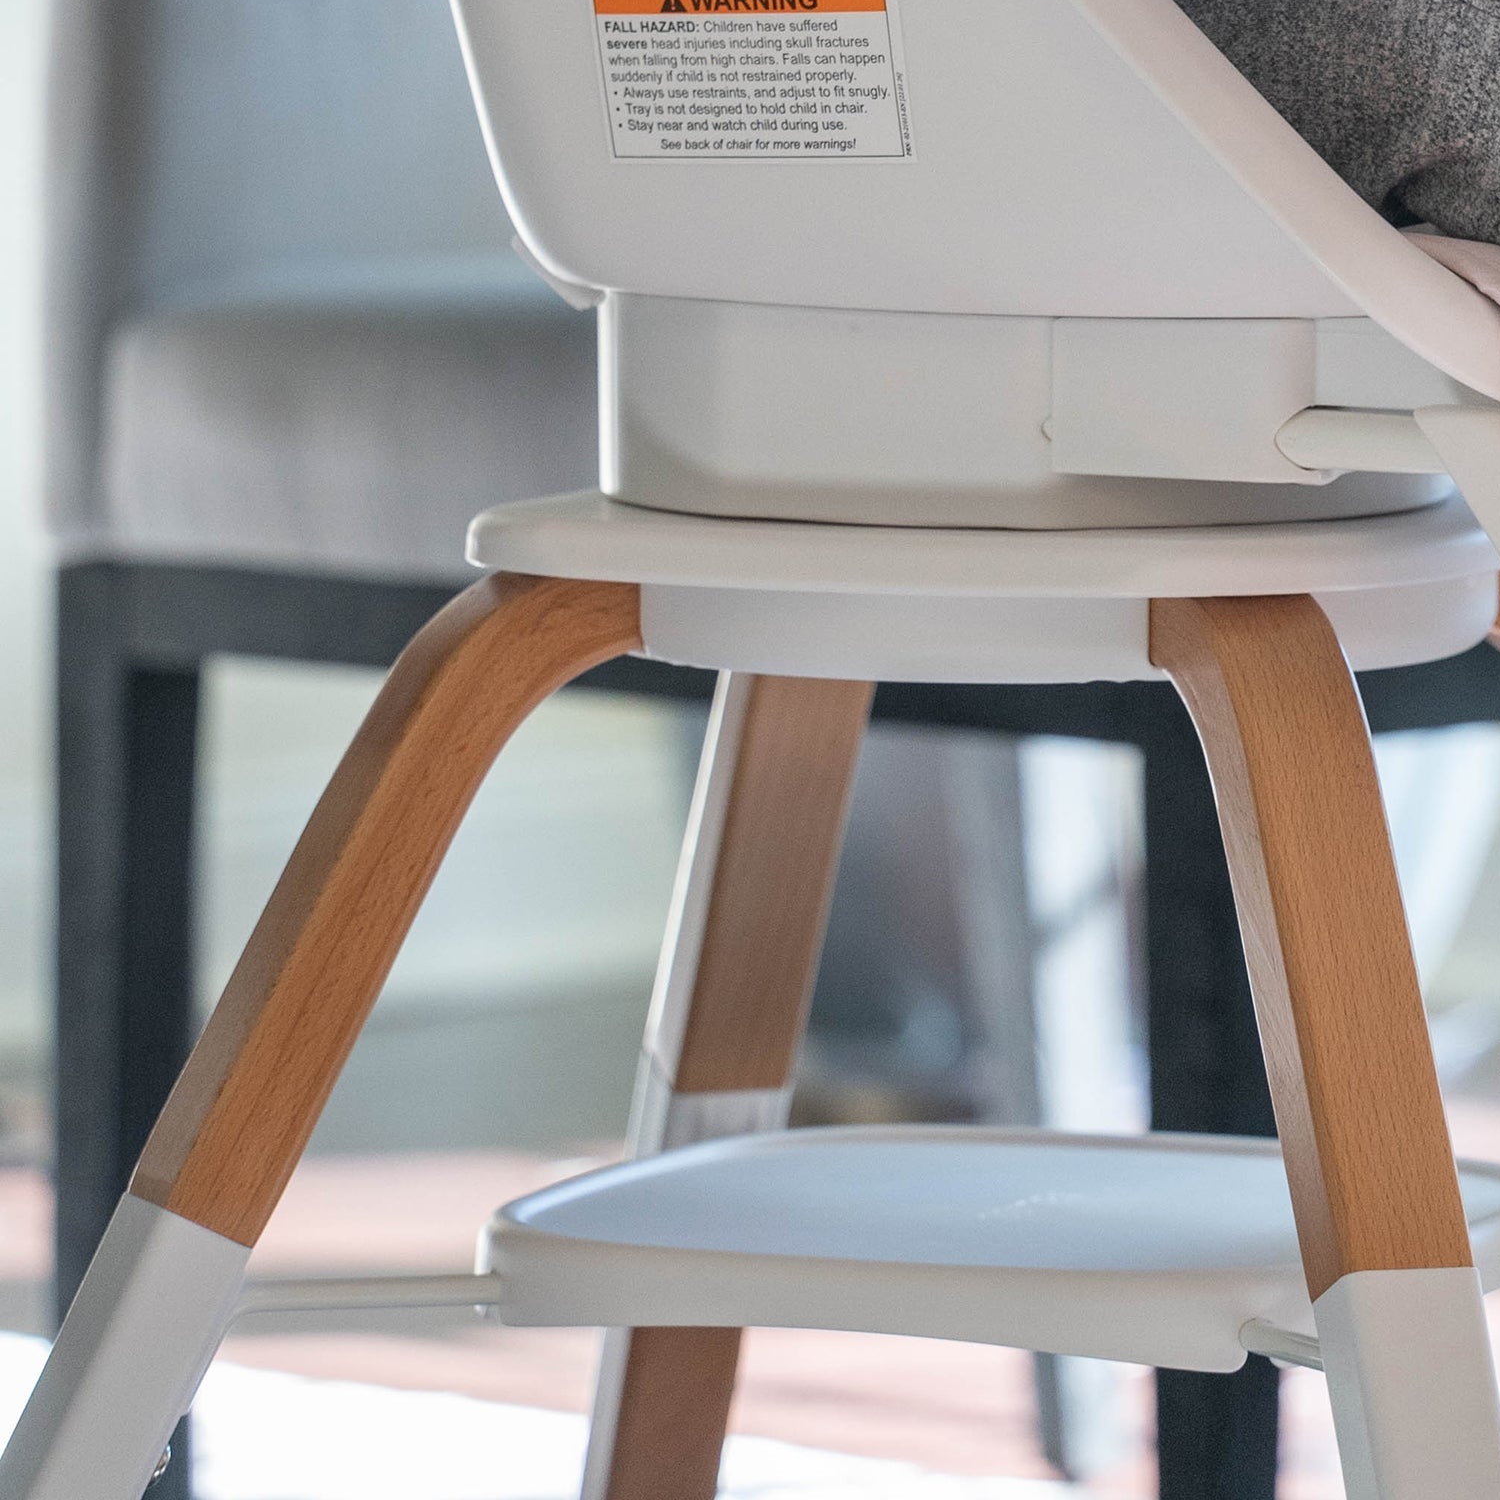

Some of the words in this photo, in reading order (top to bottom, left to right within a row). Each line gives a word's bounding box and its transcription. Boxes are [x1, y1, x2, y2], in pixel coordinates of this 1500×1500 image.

[604, 21, 637, 33] FALL
[640, 21, 700, 33] HAZARD:
[703, 20, 753, 32] Children
[756, 21, 785, 32] have
[789, 19, 838, 31] suffered
[606, 39, 648, 50] severe
[651, 37, 681, 49] head
[684, 37, 726, 52] injuries
[729, 37, 782, 51] including
[785, 36, 813, 48] skull
[816, 36, 869, 48] fractures
[608, 55, 640, 66] when
[642, 54, 678, 68] falling
[681, 54, 707, 65] from
[711, 54, 736, 68] high
[740, 54, 778, 65] chairs.
[782, 53, 811, 65] Falls
[814, 55, 837, 65] can
[840, 52, 886, 66] happen
[610, 71, 662, 85] suddenly
[666, 70, 673, 81] if
[676, 70, 704, 82] child
[707, 71, 717, 81] is
[720, 71, 738, 81] not
[742, 70, 801, 81] restrained
[805, 69, 857, 83] properly.
[623, 87, 664, 100] Always
[668, 89, 689, 98] use
[692, 87, 750, 99] restraints,
[754, 86, 776, 98] and
[780, 86, 816, 100] adjust
[819, 87, 831, 98] to
[834, 85, 845, 97] fit
[849, 85, 891, 100] snugly.
[625, 103, 651, 117] Tray
[655, 103, 664, 114] is
[668, 104, 686, 114] not
[689, 103, 742, 117] designed
[746, 104, 757, 114] to
[761, 102, 786, 114] hold
[789, 102, 817, 114] child
[821, 103, 831, 113] in
[835, 102, 868, 113] chair.
[627, 119, 653, 133] Stay
[657, 121, 683, 131] near
[687, 120, 709, 131] and
[713, 120, 747, 130] watch
[750, 119, 777, 130] child
[781, 119, 819, 133] during
[822, 121, 847, 130] use.
[660, 138, 682, 149] See
[685, 138, 710, 149] back
[713, 138, 724, 149] of
[726, 138, 752, 149] chair
[755, 138, 770, 149] for
[773, 140, 801, 149] more
[804, 138, 857, 151] warnings!
